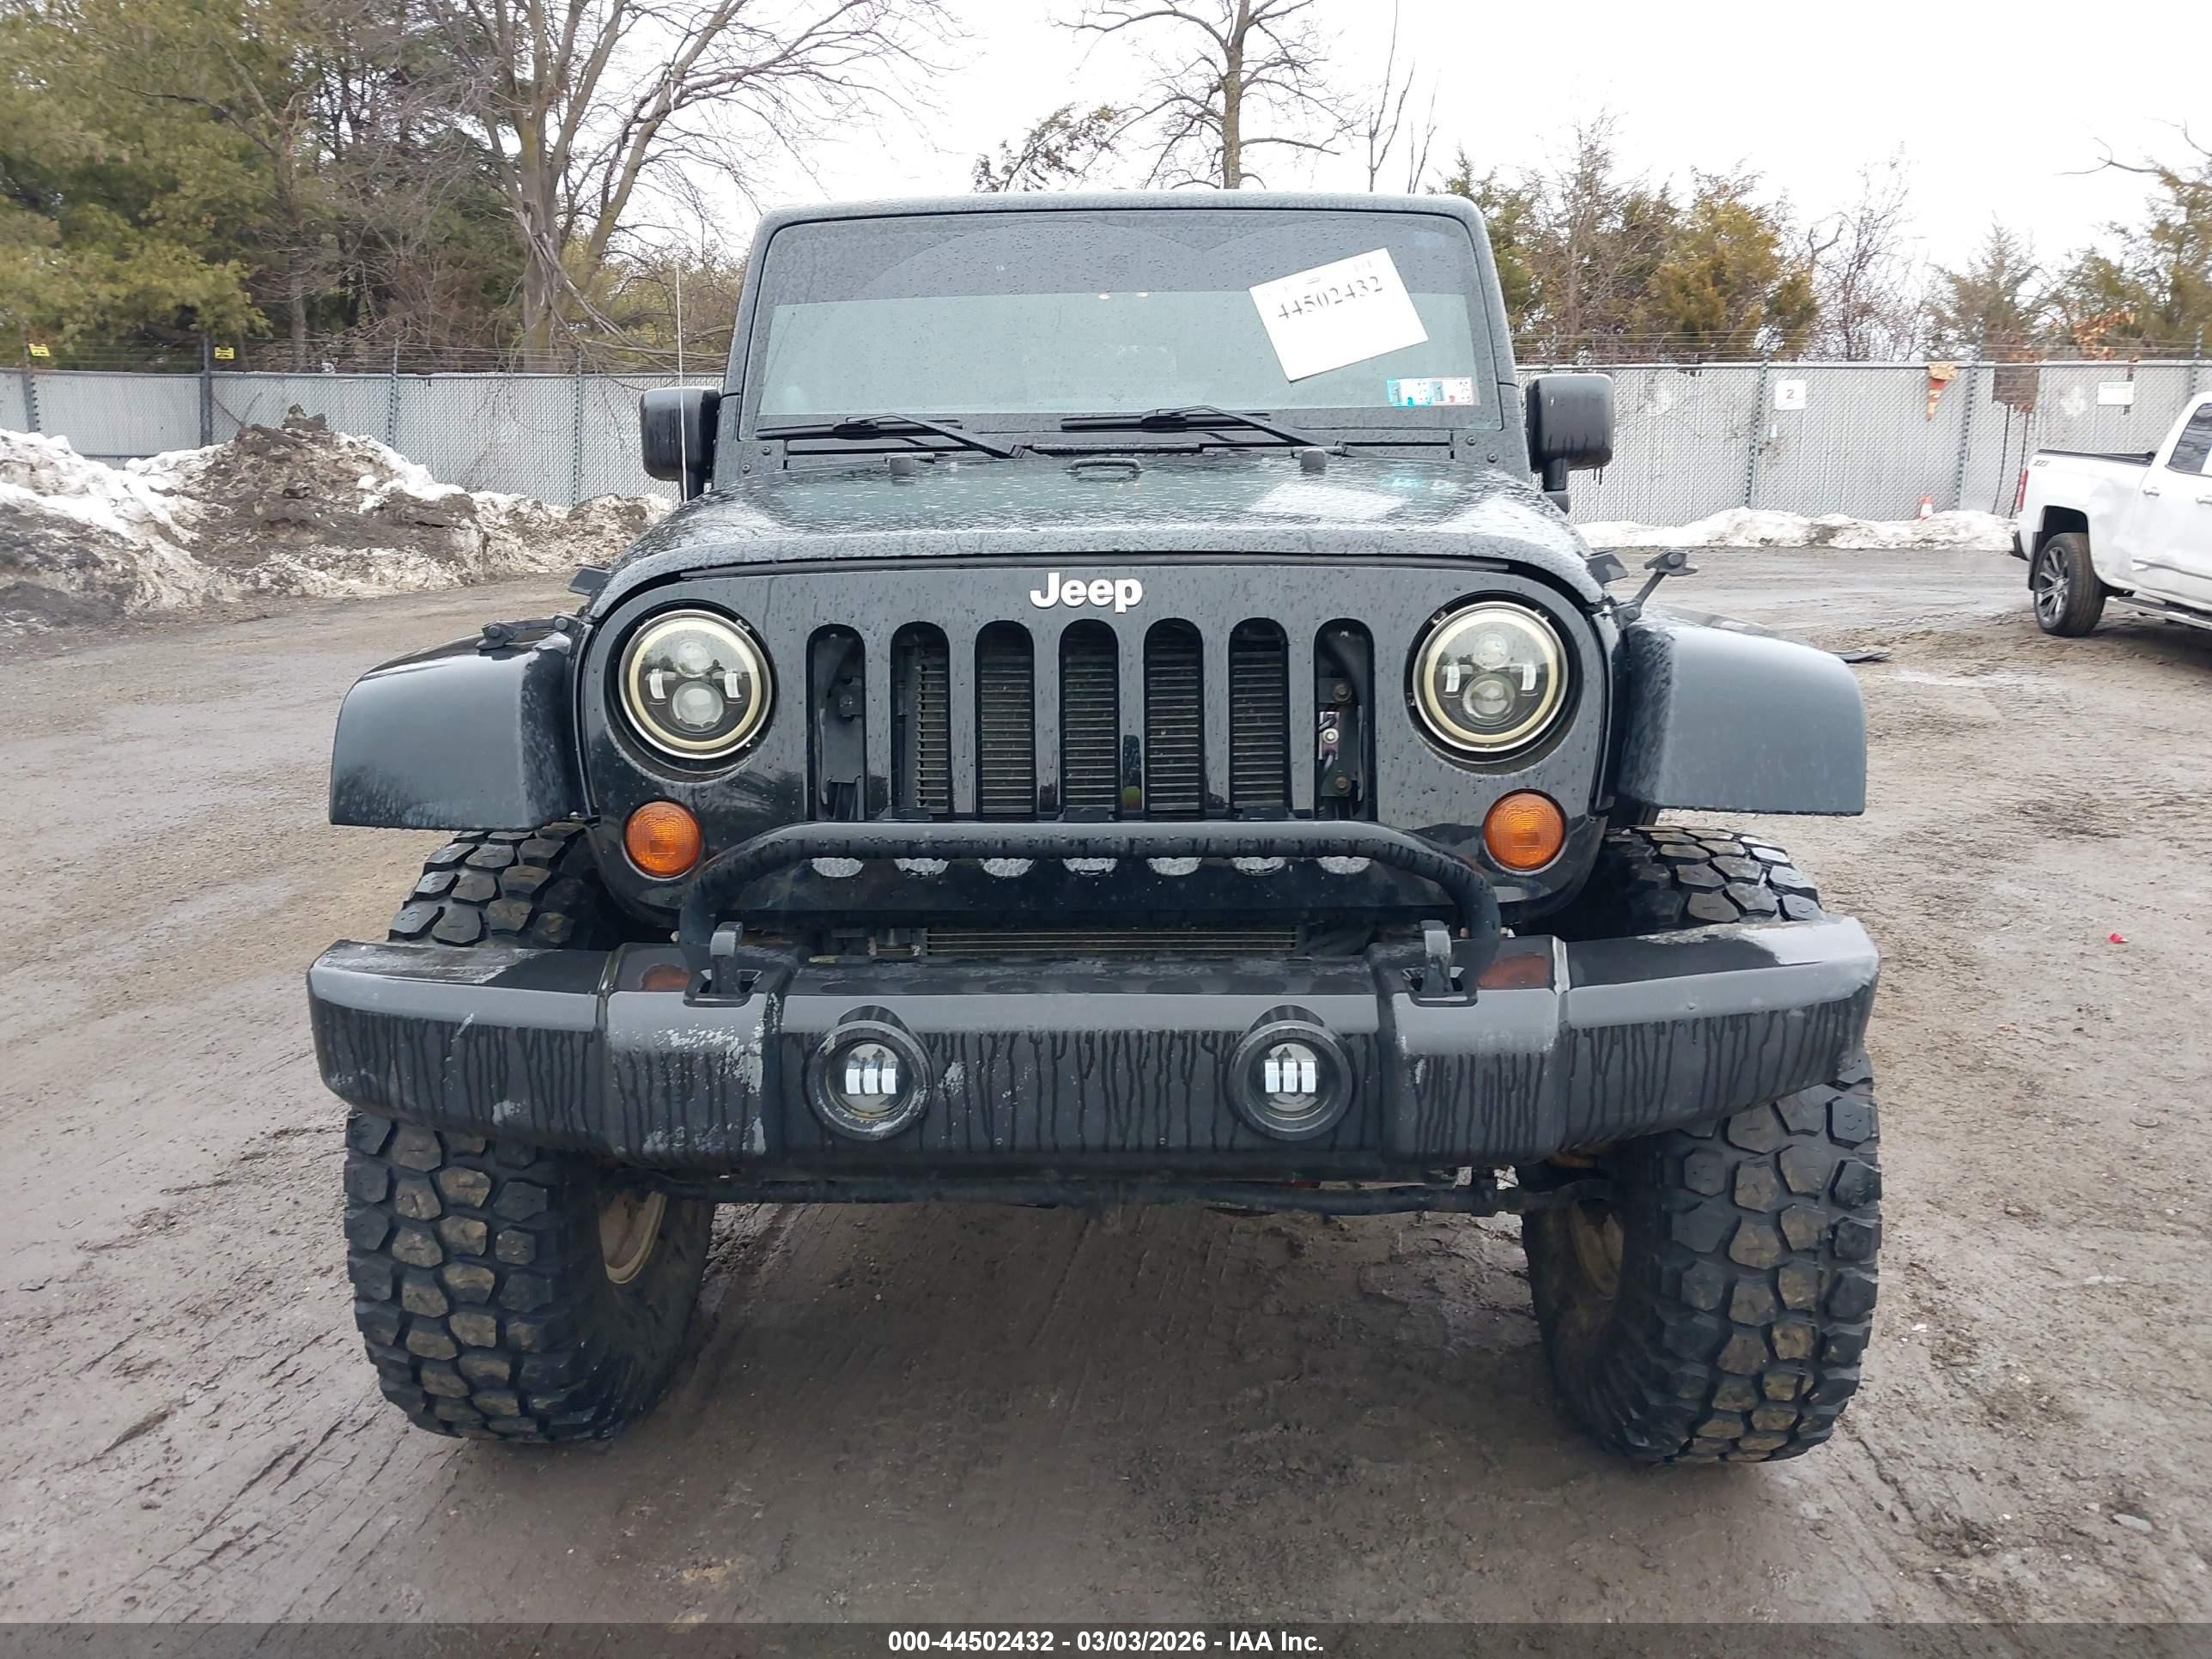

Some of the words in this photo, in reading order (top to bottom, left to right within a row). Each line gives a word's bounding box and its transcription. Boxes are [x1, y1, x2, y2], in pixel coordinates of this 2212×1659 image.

[1277, 275, 1384, 319] 44502432
[1786, 389, 1795, 399] 2
[1030, 572, 1144, 614] Jeep
